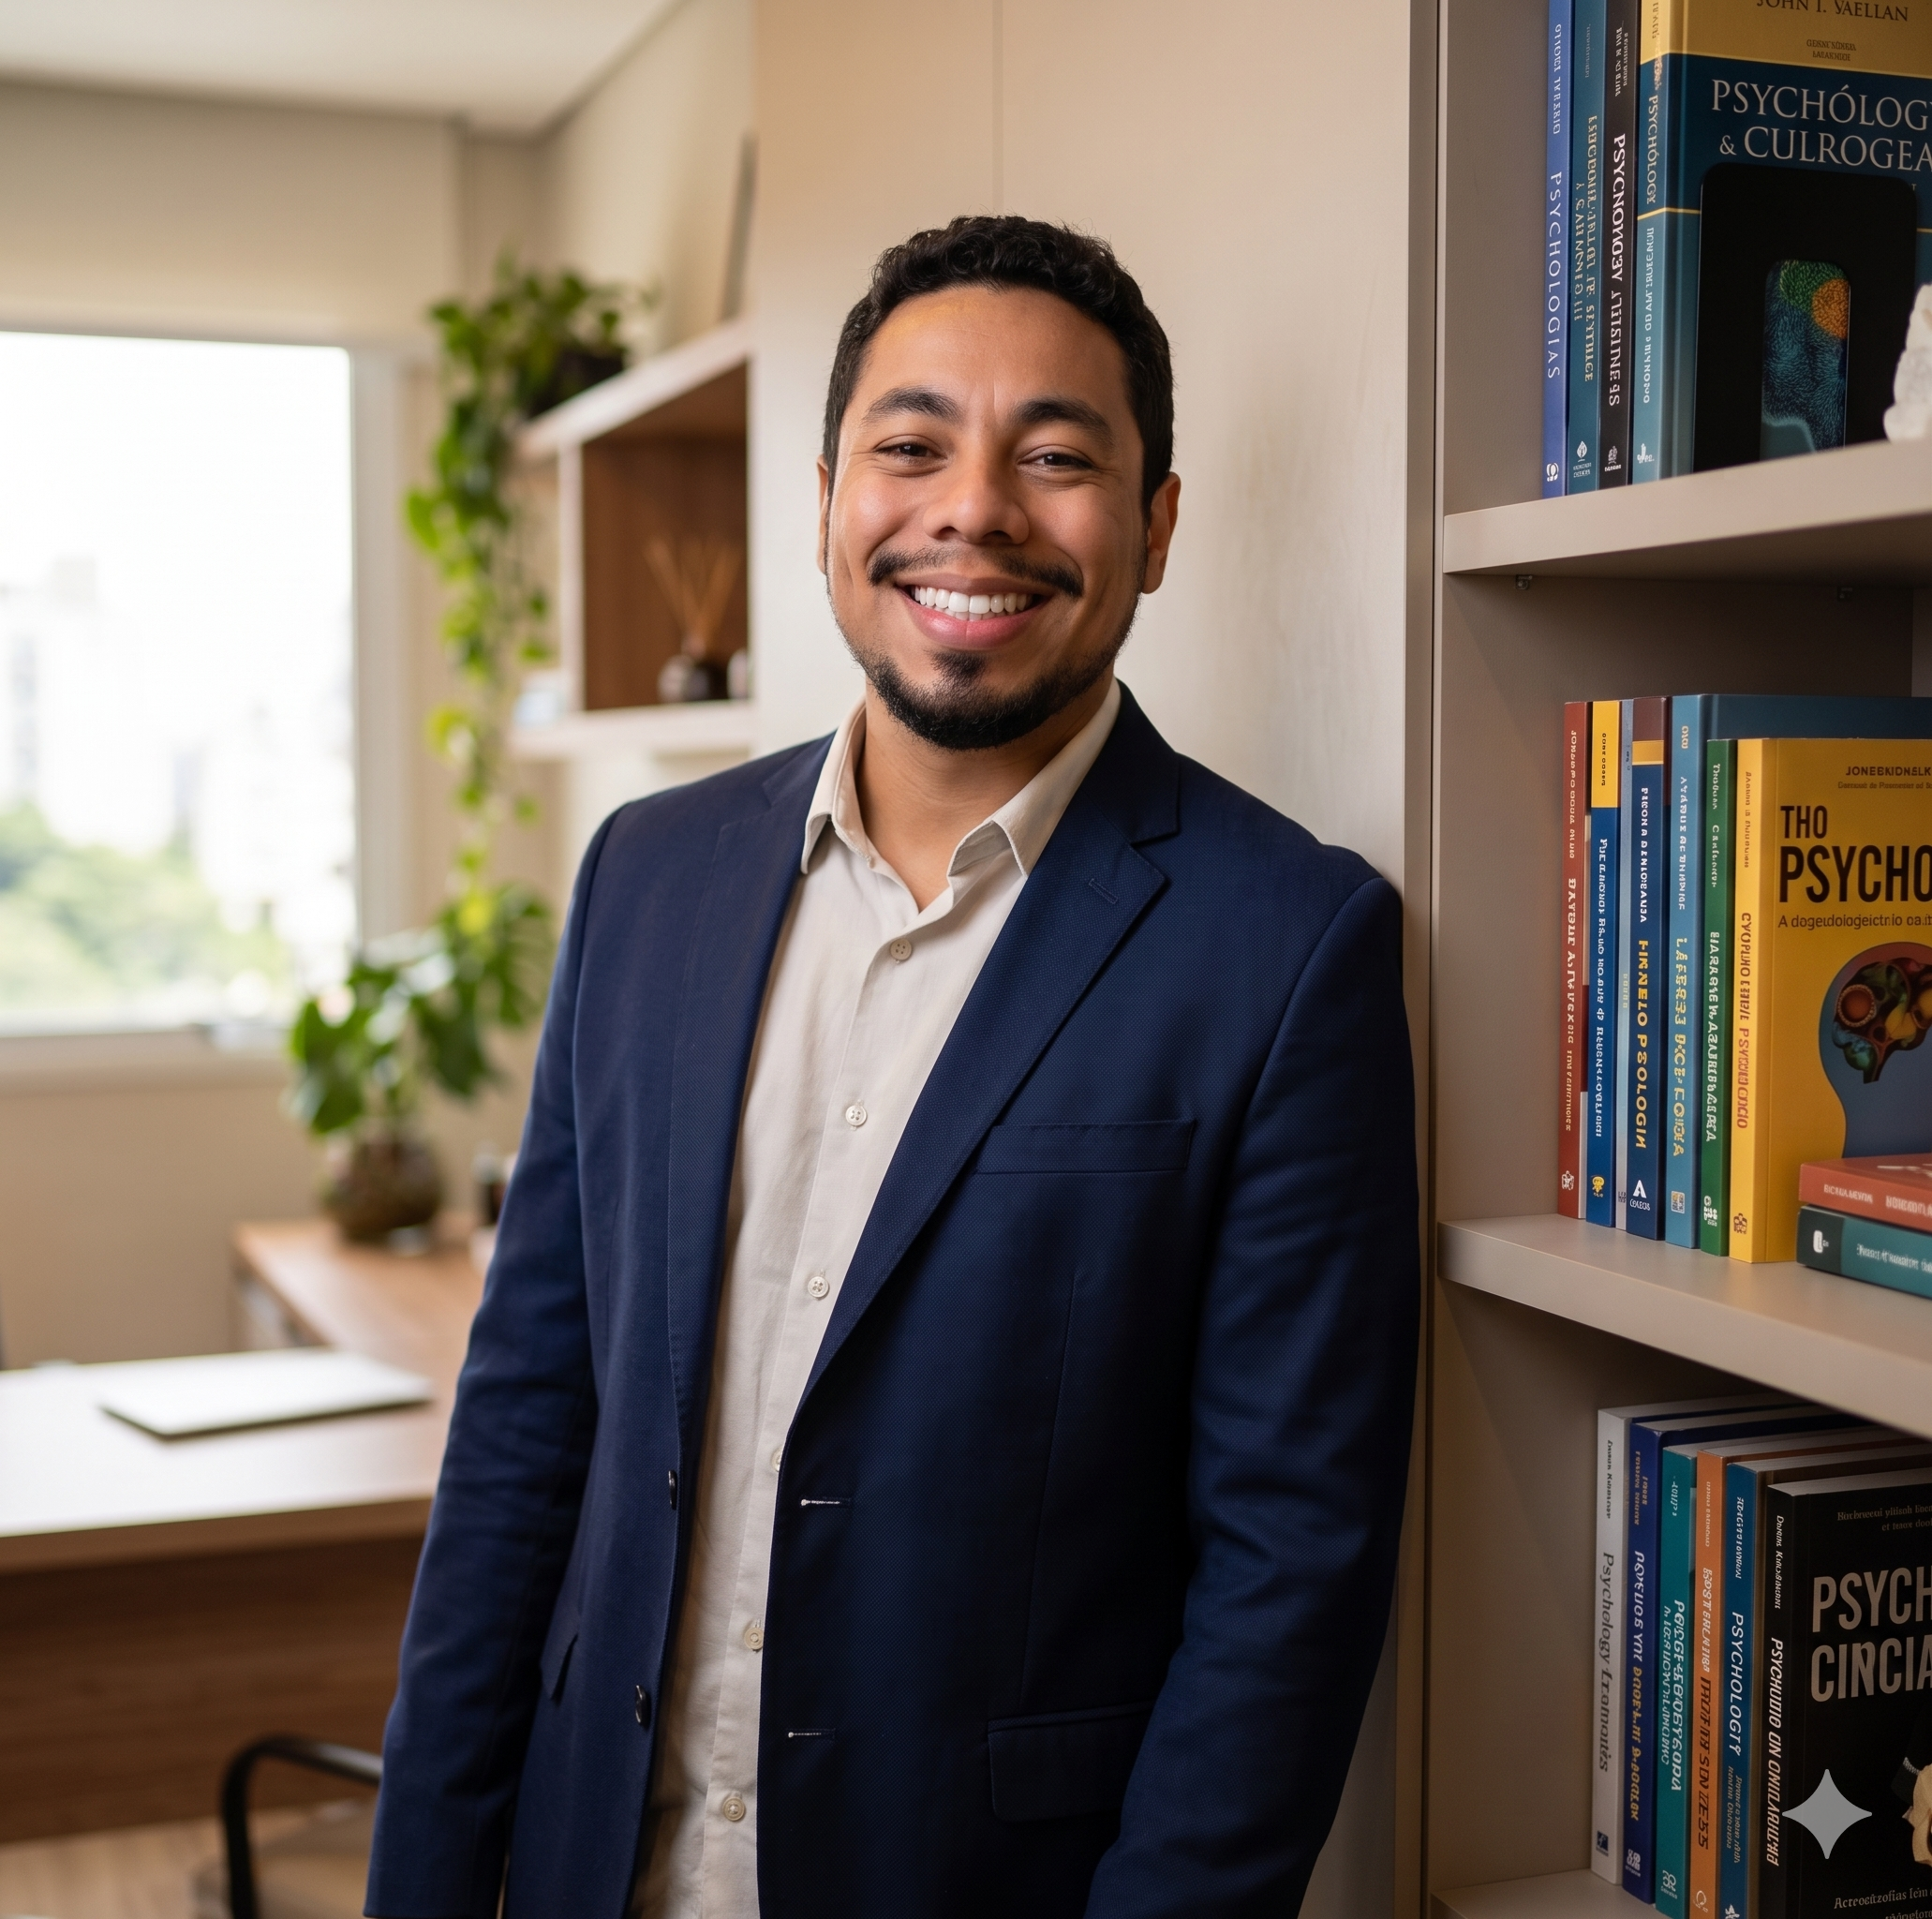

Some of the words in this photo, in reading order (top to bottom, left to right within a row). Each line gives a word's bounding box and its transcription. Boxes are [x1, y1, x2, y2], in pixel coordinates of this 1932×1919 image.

[1712, 80, 1932, 131] PSYCHÓLOG
[1719, 135, 1737, 156] &
[1548, 171, 1562, 379] PSYCHOLOGIAS
[1780, 805, 1827, 839] THO
[1779, 845, 1932, 903] PSYCHO
[1778, 915, 1788, 928] A
